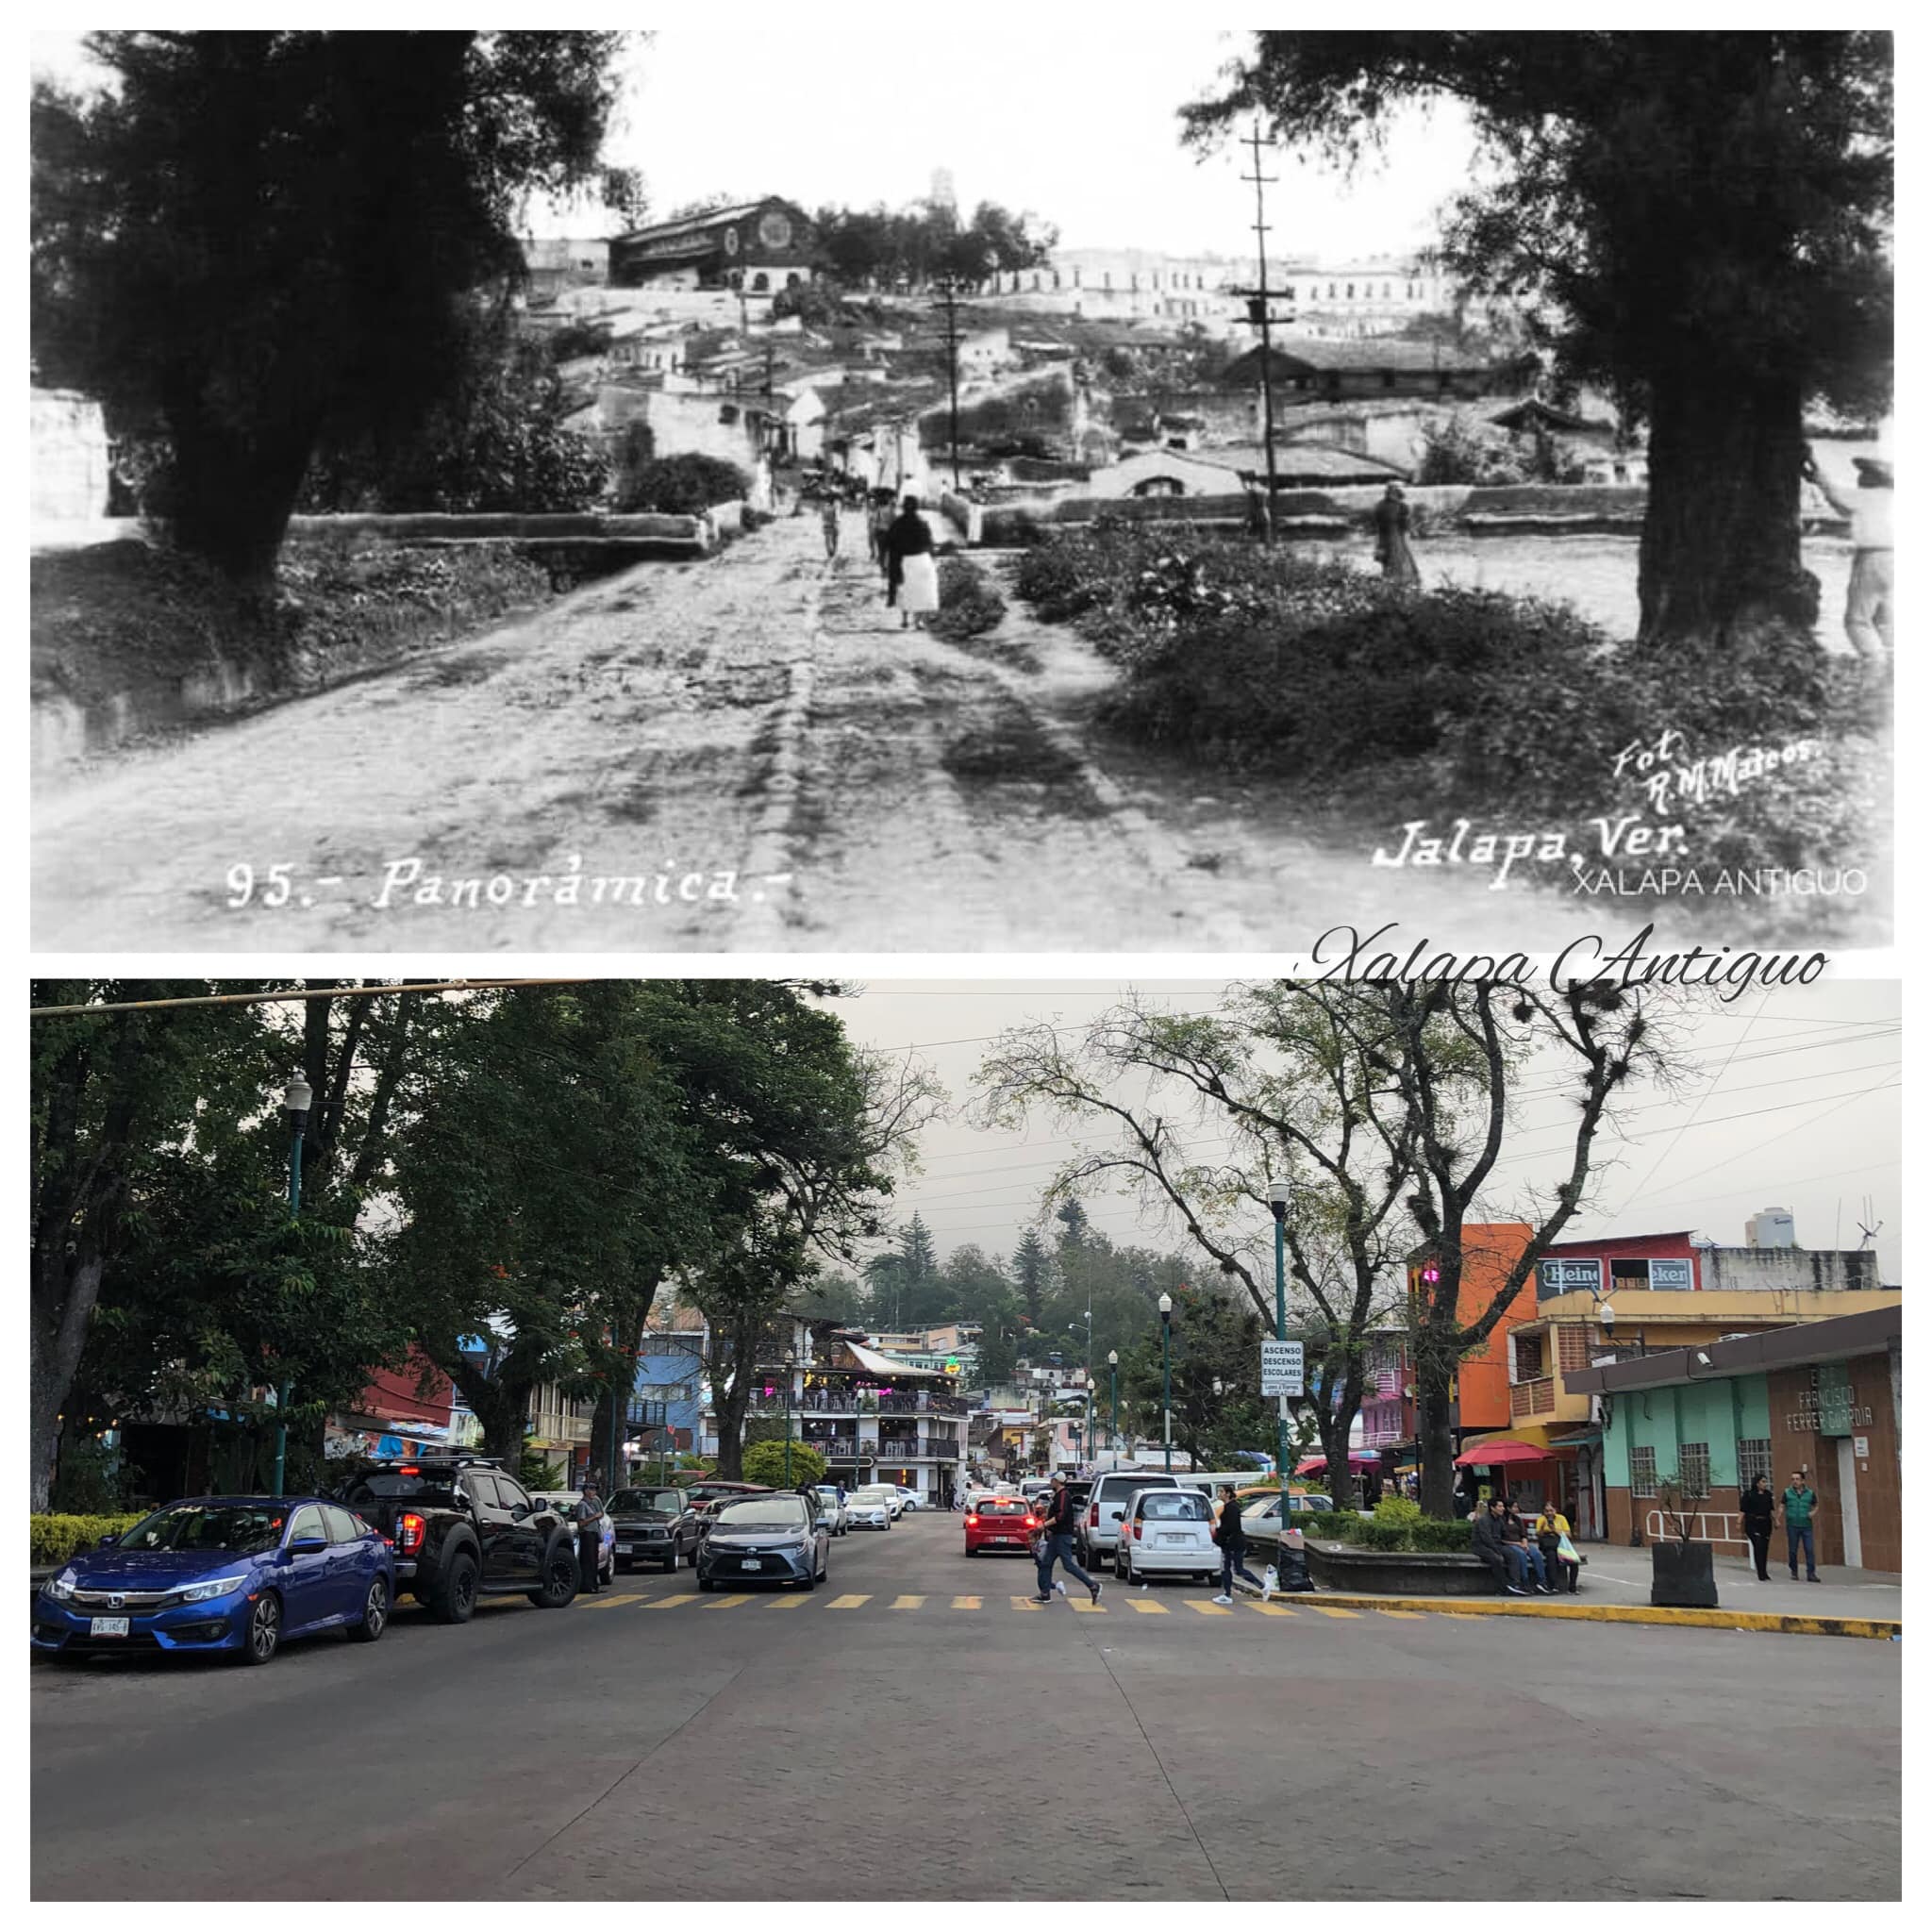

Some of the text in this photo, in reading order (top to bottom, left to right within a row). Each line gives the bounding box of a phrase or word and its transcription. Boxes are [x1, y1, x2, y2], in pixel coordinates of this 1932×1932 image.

[1264, 1346, 1301, 1355] ASCENSO
[1263, 1368, 1301, 1376] ESCOLARES
[1798, 1385, 1856, 1411] FRANCISCO
[1787, 1407, 1873, 1431] FERRER GUARDIA
